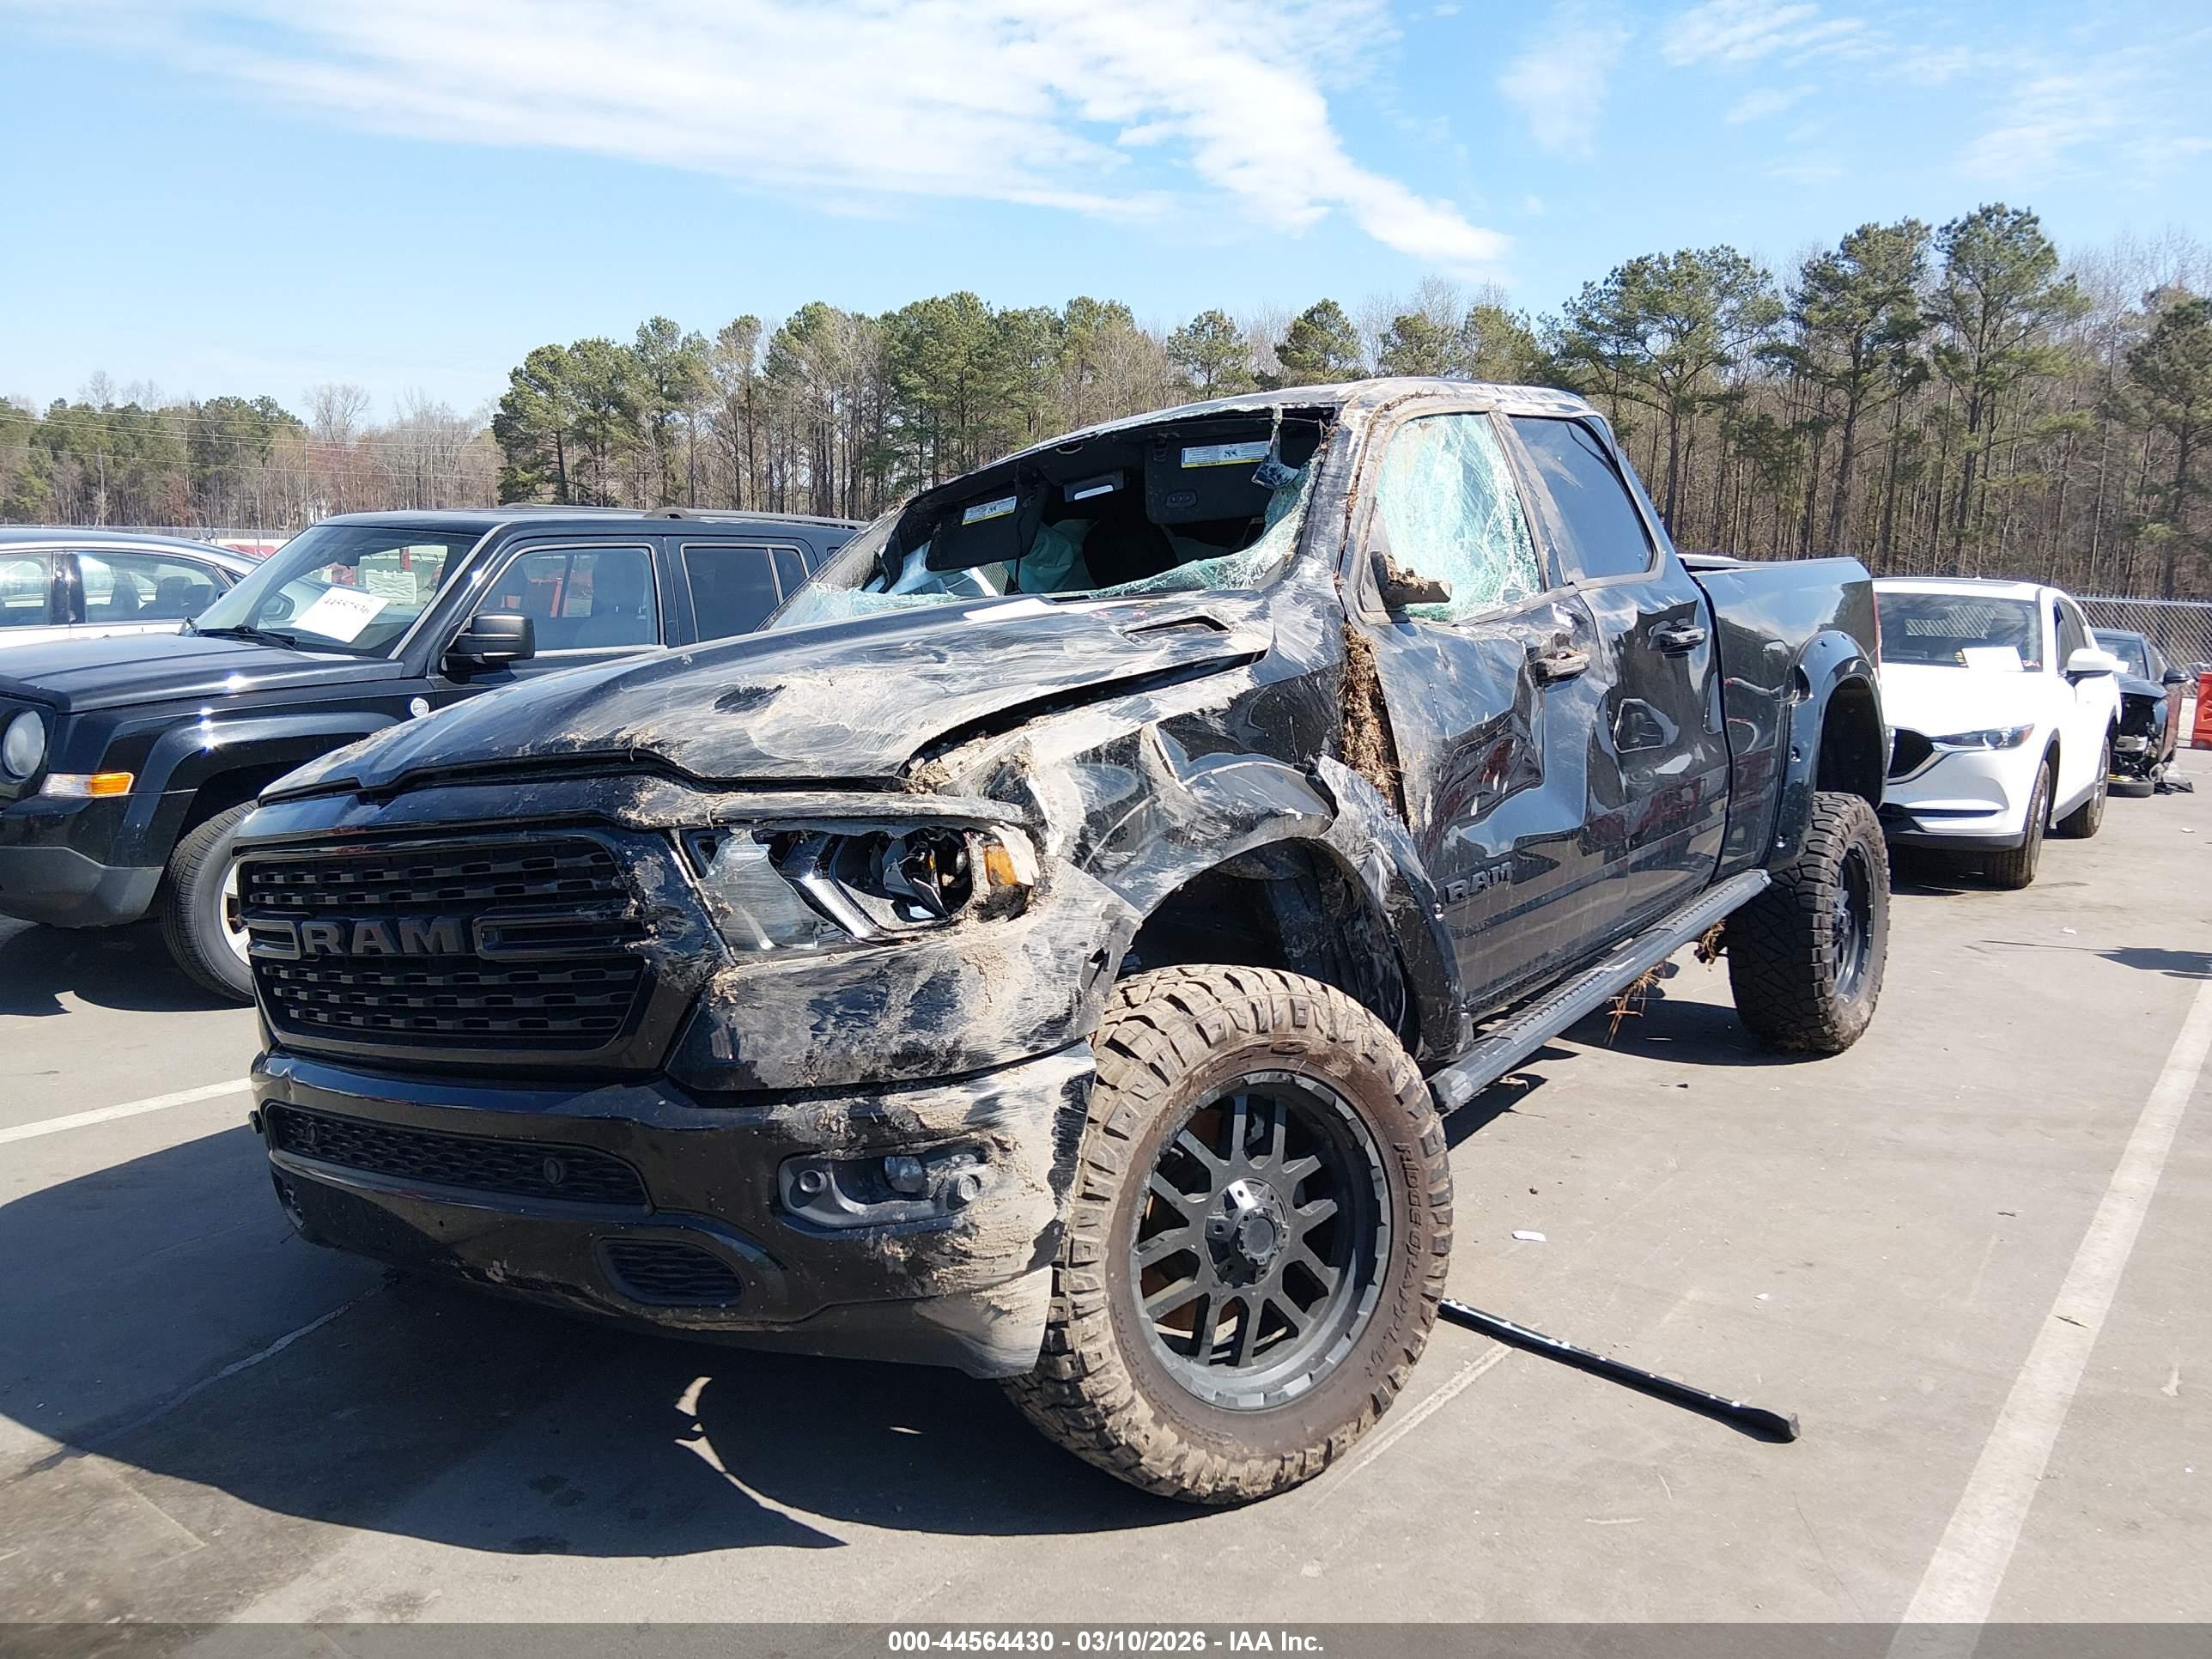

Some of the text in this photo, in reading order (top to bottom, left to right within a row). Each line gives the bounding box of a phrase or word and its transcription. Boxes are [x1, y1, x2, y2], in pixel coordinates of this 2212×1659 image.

[1444, 861, 1512, 904] RAM
[301, 920, 462, 955] RAM
[1392, 1140, 1422, 1228] RIDGE
